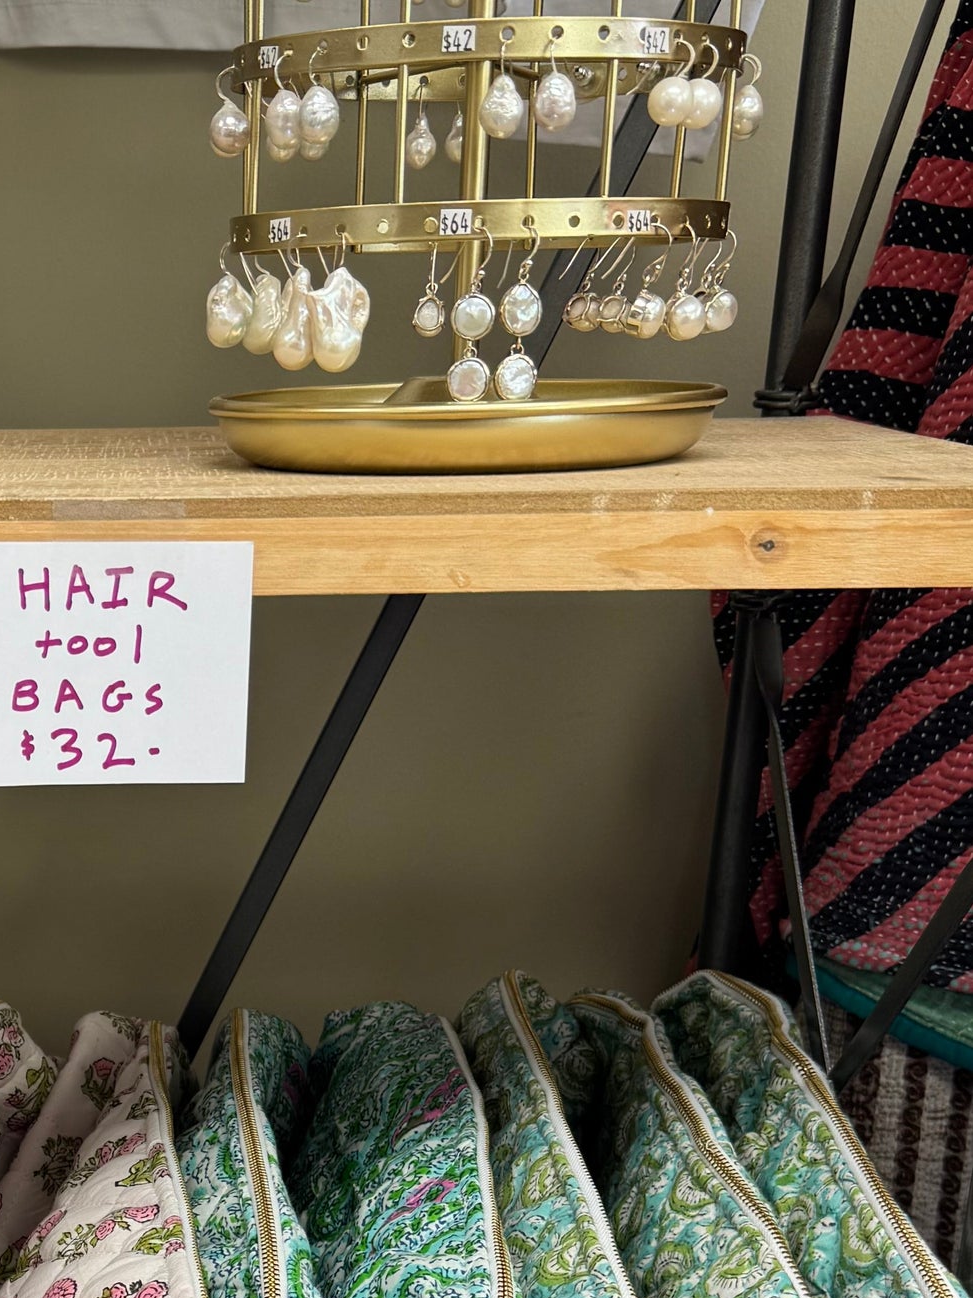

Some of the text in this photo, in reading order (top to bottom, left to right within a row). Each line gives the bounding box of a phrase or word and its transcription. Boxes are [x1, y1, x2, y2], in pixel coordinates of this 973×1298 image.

[444, 27, 473, 53] $42
[646, 30, 667, 54] $42
[270, 219, 289, 242] $64
[441, 211, 469, 235] $64
[628, 210, 649, 233] $64
[18, 564, 188, 612] HAIR
[35, 624, 143, 664] tool
[11, 678, 163, 715] BAGS
